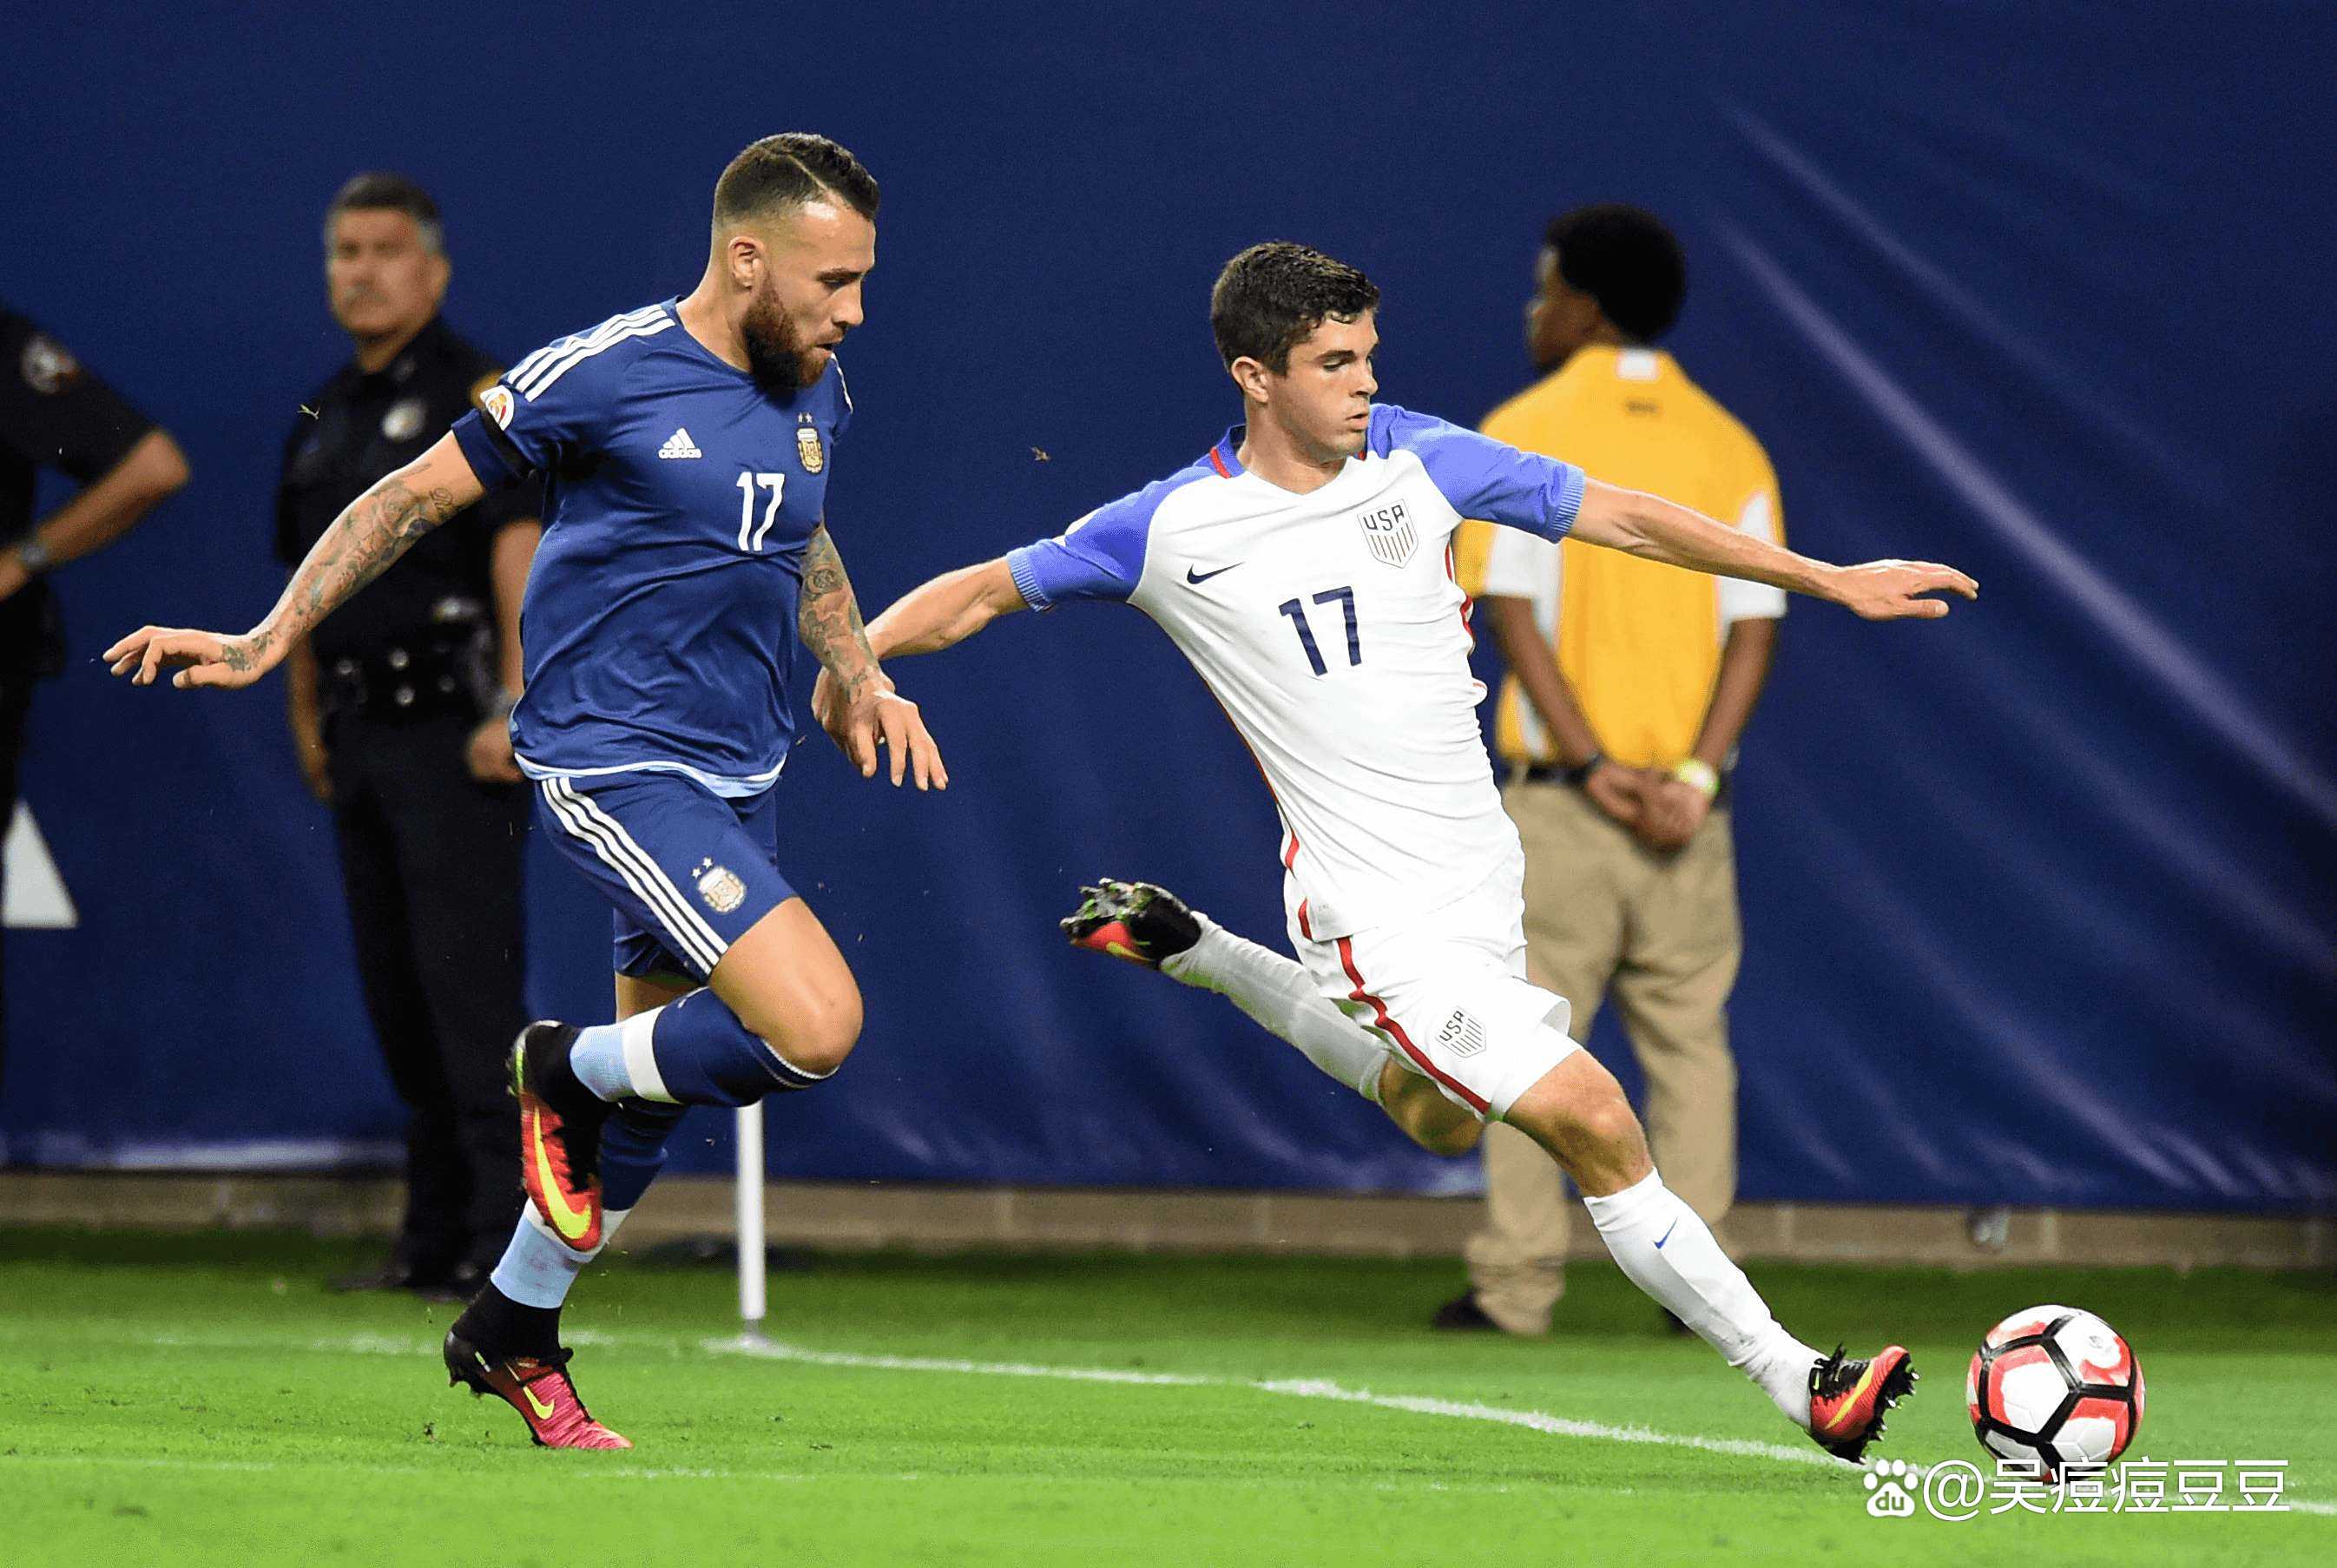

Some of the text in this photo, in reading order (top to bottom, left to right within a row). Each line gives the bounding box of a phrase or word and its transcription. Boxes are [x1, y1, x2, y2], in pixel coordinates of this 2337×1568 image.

[736, 471, 785, 551] 17
[1363, 504, 1405, 531] USA
[1278, 585, 1362, 676] 17
[1439, 1011, 1465, 1041] USA
